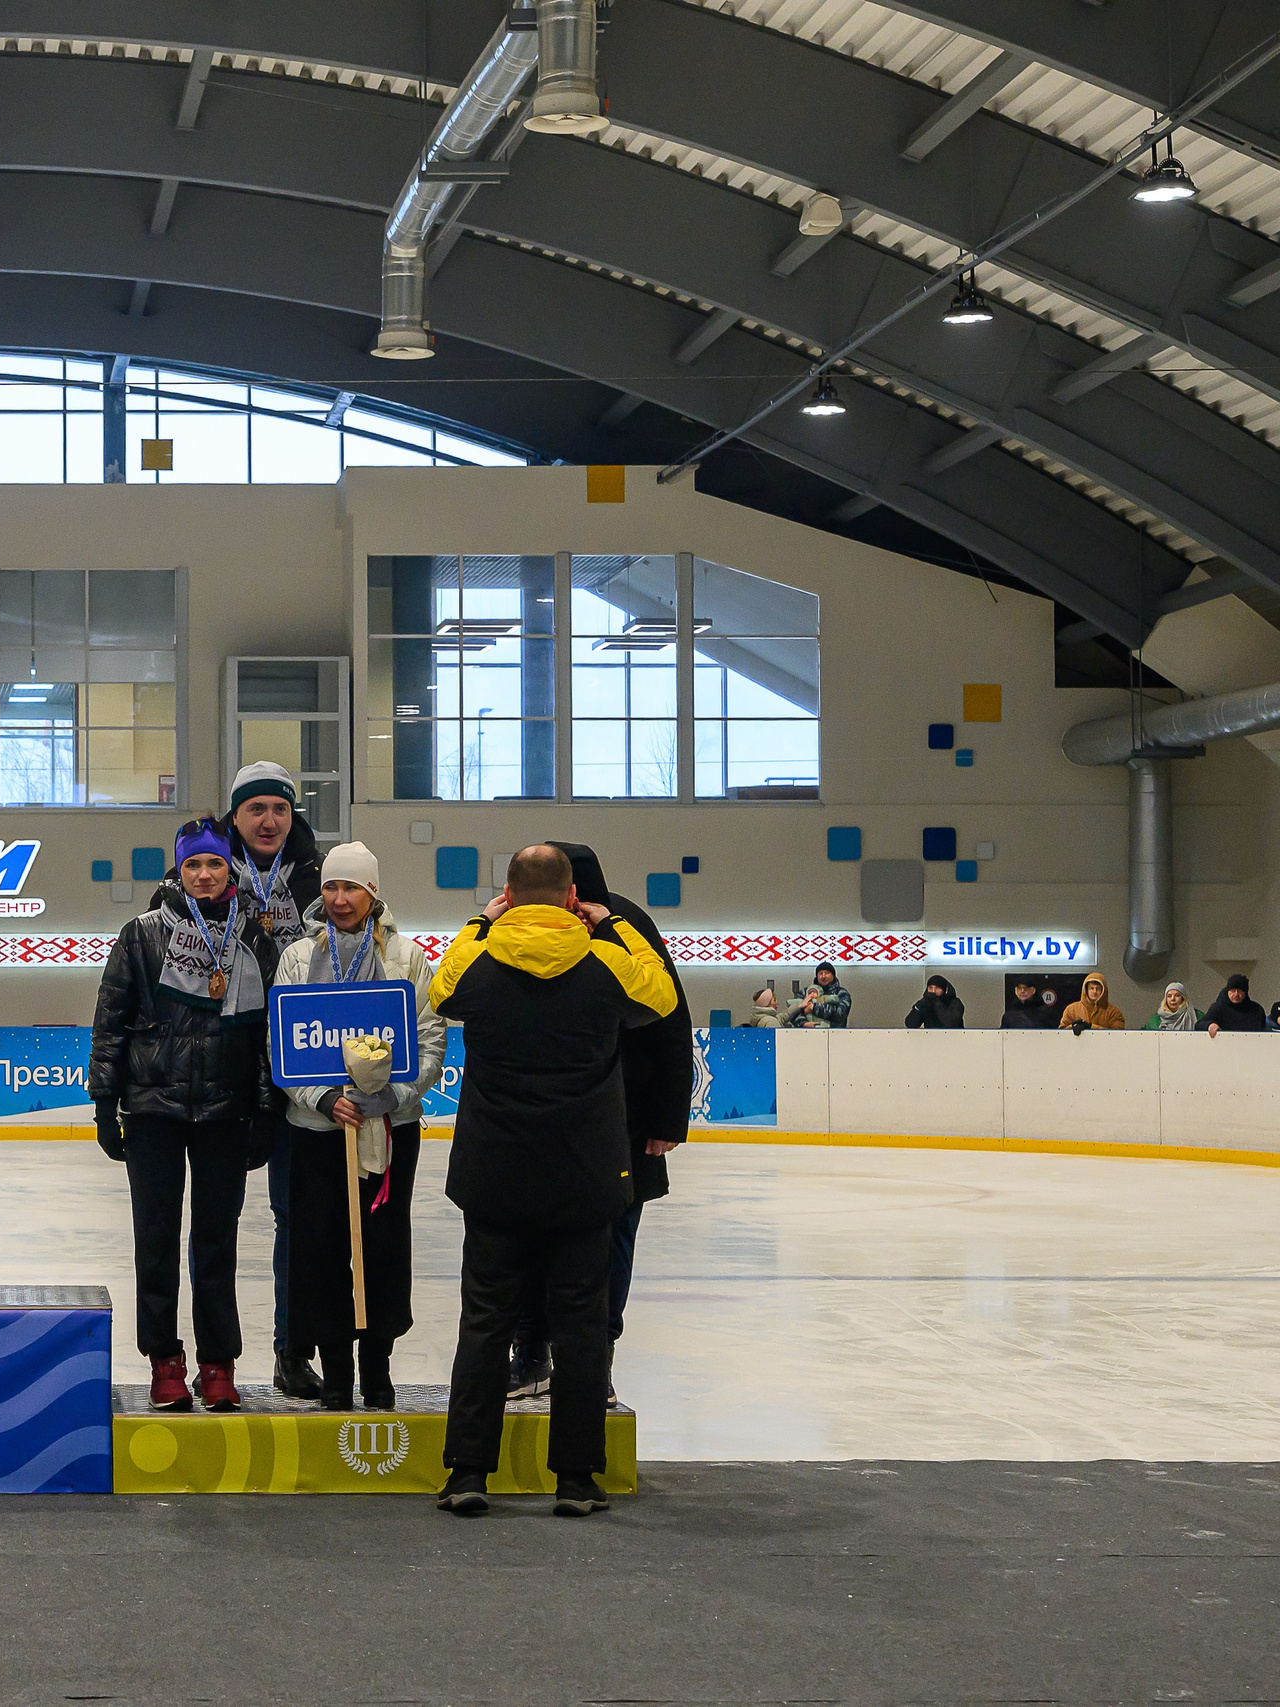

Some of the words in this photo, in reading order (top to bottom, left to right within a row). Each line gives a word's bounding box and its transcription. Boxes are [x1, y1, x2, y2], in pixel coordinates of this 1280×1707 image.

[244, 906, 293, 921] ЕДНЫЕ
[943, 936, 1081, 960] silichy.by
[350, 1423, 398, 1454] III
